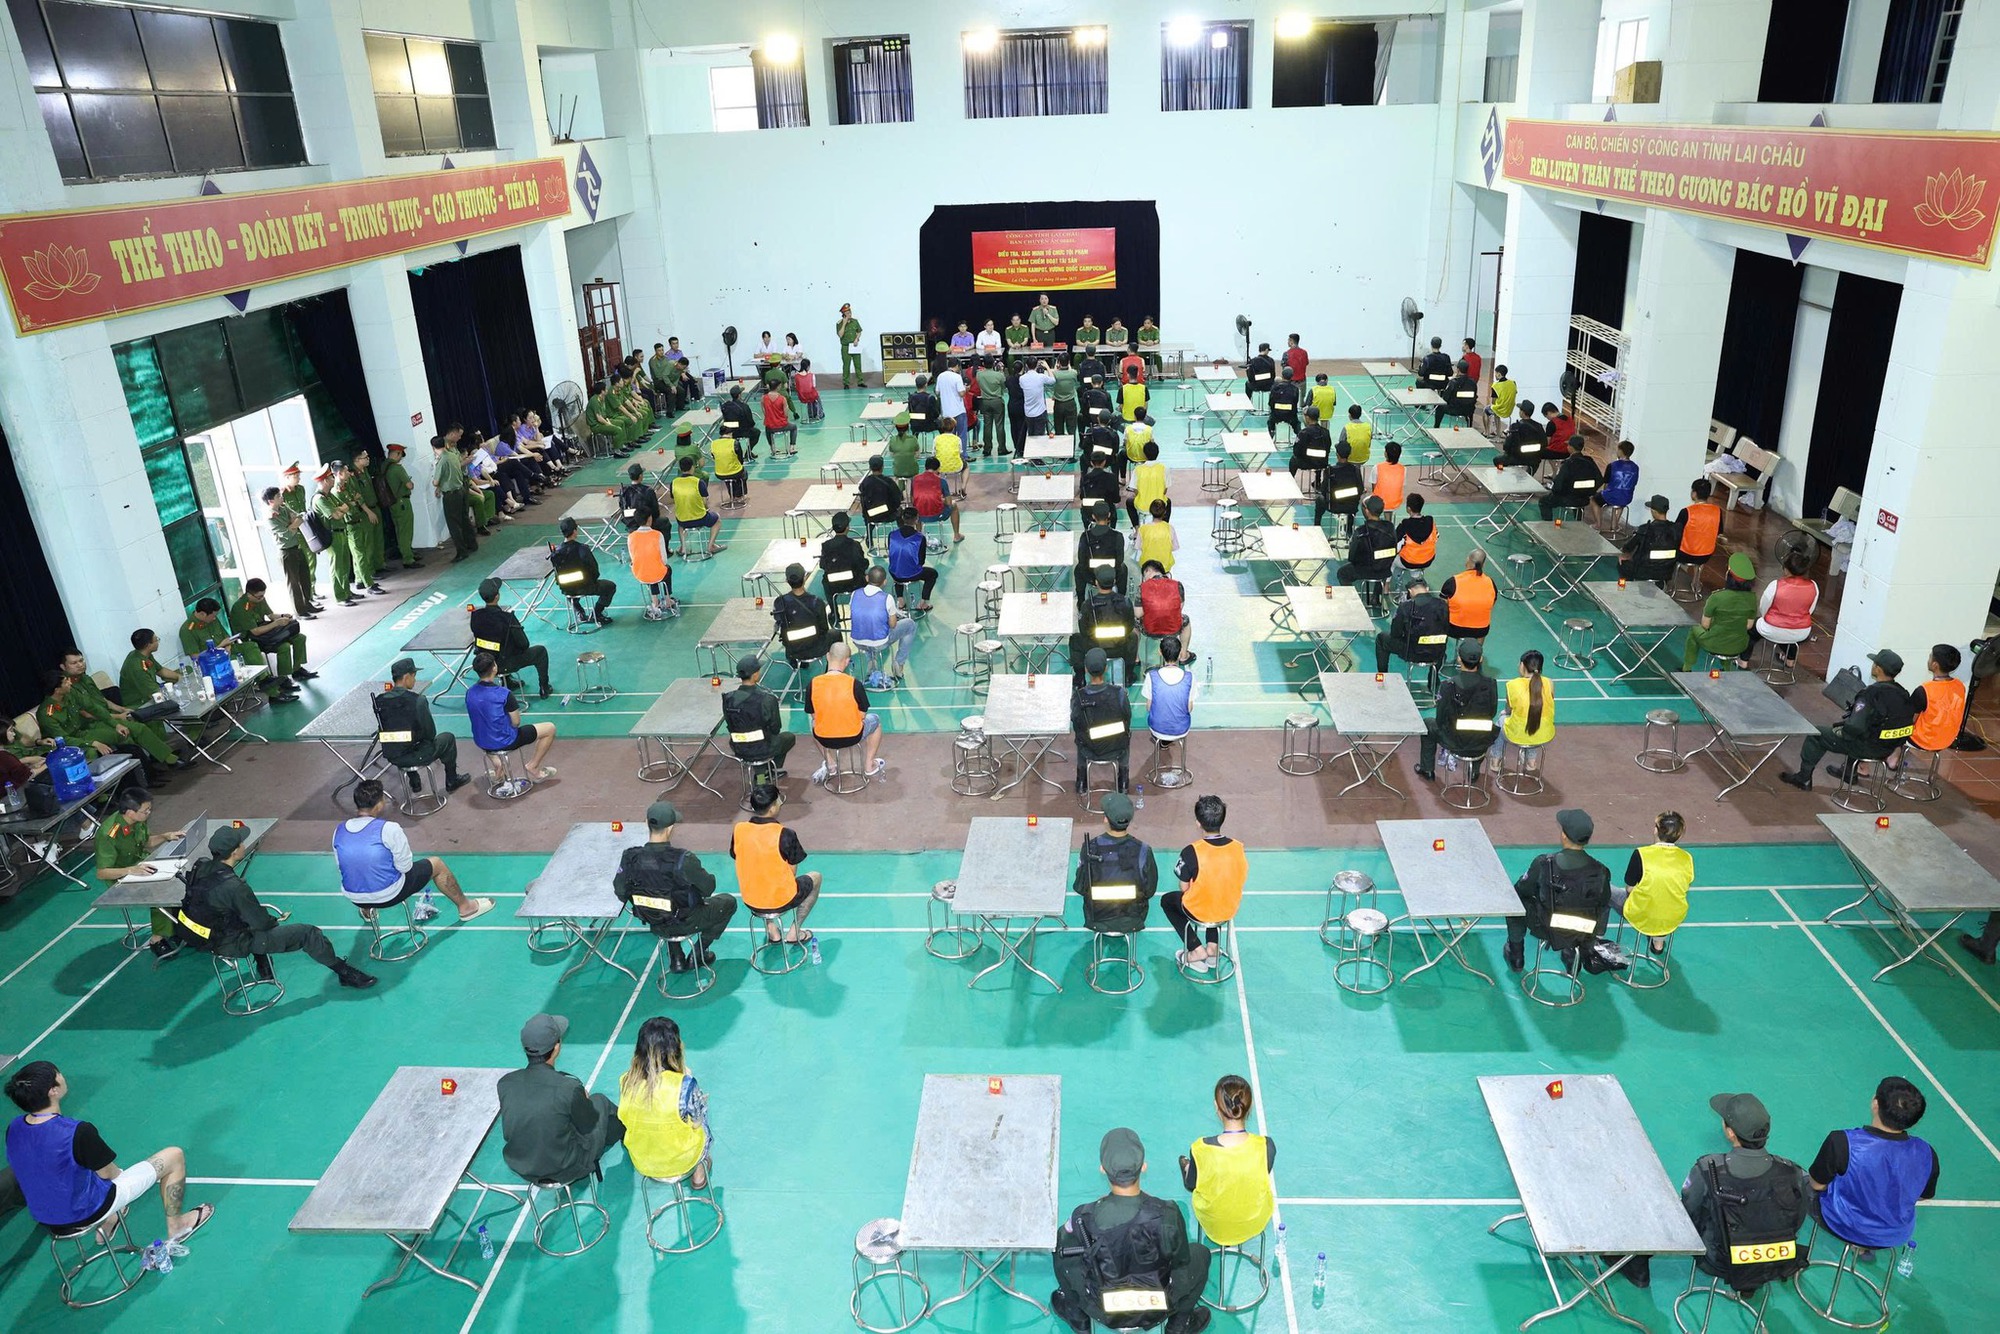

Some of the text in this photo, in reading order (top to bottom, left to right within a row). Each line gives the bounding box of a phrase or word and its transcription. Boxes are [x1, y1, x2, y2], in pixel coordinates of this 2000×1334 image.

[1566, 131, 1806, 168] CÁN BỘ, CHIẾN SỸ CÔNG AN TỈNH LAI CHÂU
[1530, 153, 1888, 237] RÈN LUYỆN THÂN THỂ THEO GƯƠNG BÁC HỒ VĨ ĐẠI
[109, 216, 165, 284] THỂ
[161, 226, 223, 275] THAO
[239, 208, 293, 262] ĐOÀN
[292, 201, 327, 252] KẾT
[338, 202, 389, 242] TRUNG
[387, 197, 423, 237] THỰC
[432, 192, 456, 225] CAO
[456, 186, 498, 222] THƯỢNG
[504, 172, 527, 211] TIẾN
[525, 173, 540, 212] BỘ
[442, 1080, 452, 1090] 42
[1552, 1083, 1561, 1093] 44
[1739, 1245, 1789, 1262] CSCĐ
